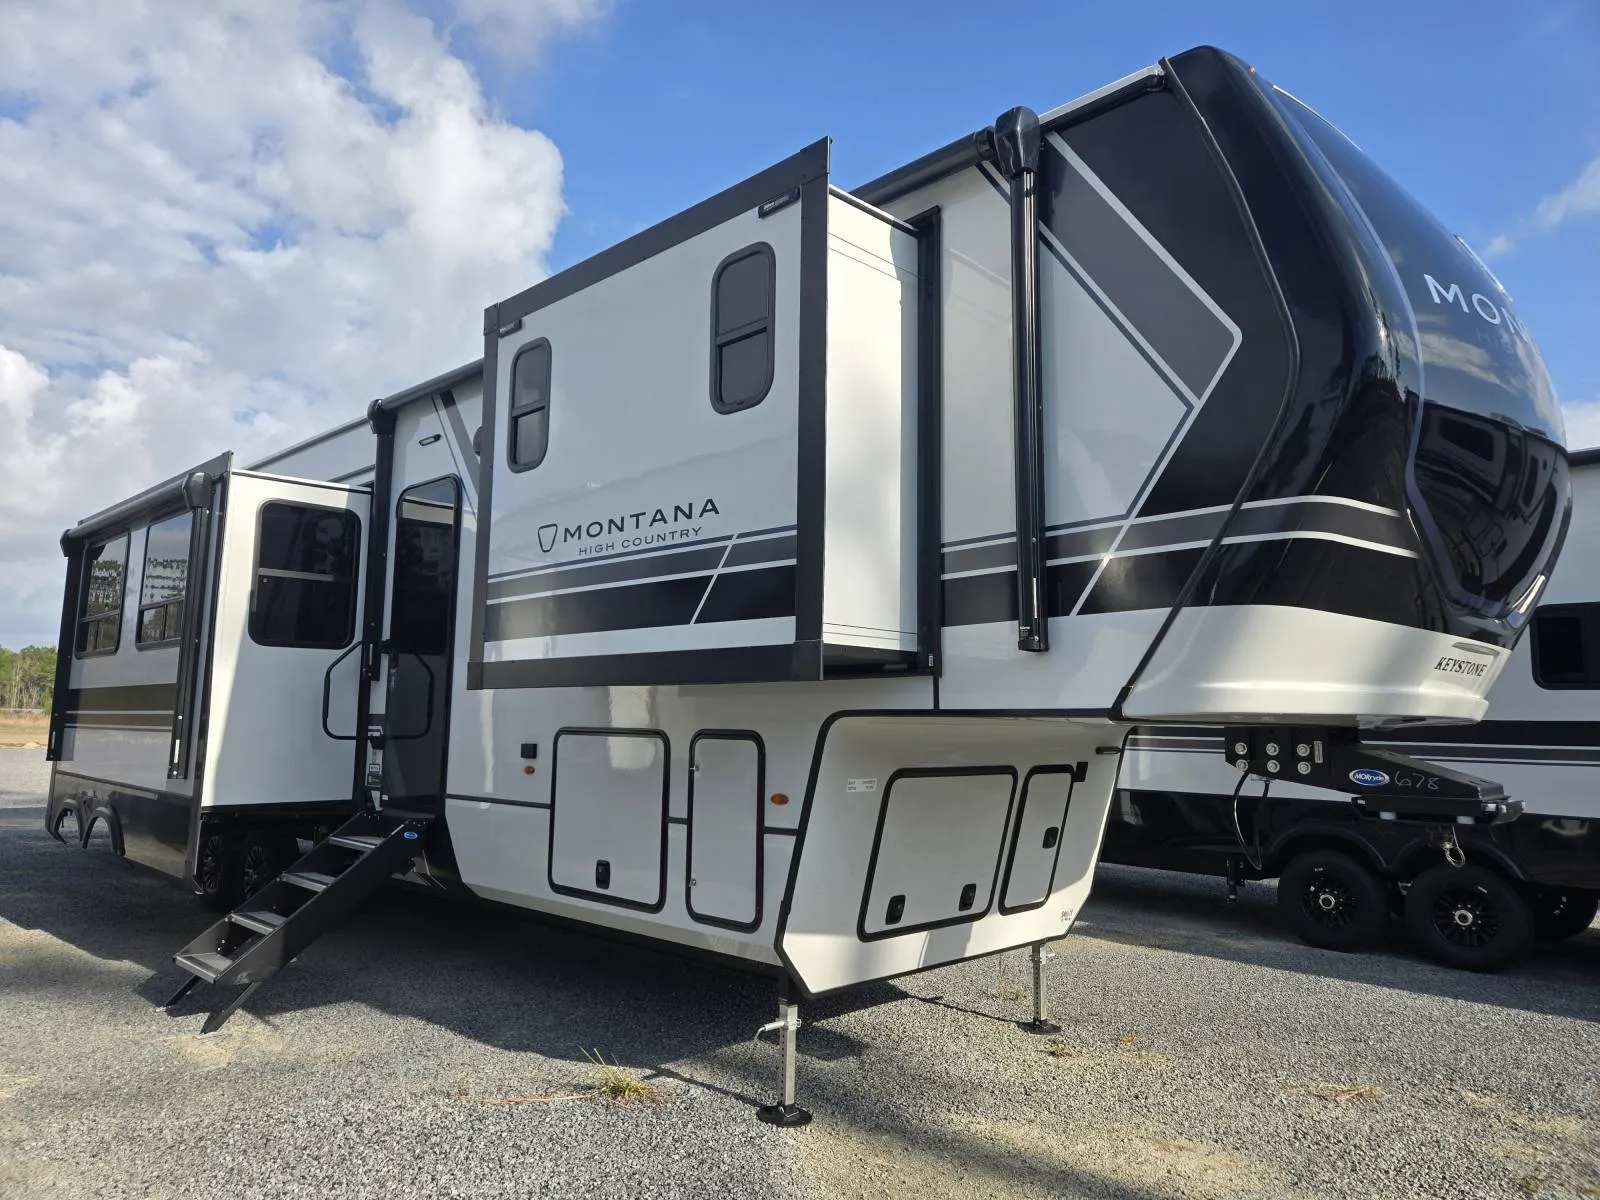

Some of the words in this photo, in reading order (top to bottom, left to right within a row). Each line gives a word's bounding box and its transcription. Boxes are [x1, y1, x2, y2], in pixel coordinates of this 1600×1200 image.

[563, 498, 720, 543] MONTANA
[579, 541, 615, 556] HIGH
[621, 526, 702, 549] COUNTRY
[1434, 656, 1488, 677] KEYSTONE
[1394, 770, 1440, 790] 678
